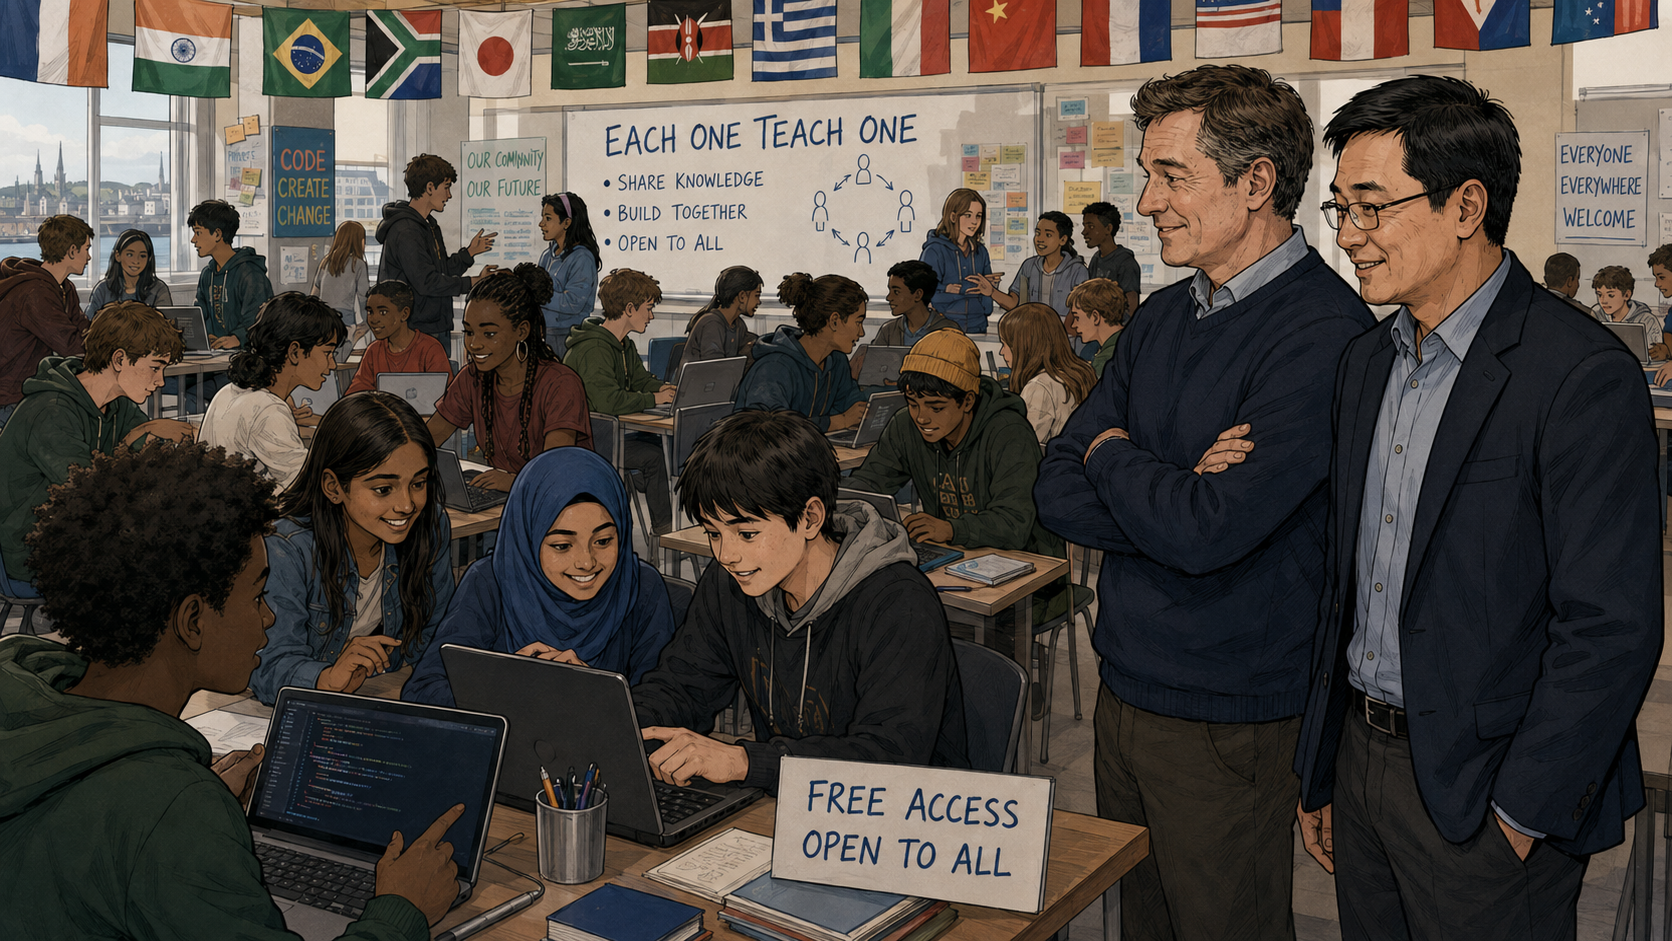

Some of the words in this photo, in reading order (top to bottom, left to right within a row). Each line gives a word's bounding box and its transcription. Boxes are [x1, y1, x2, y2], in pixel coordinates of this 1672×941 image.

[605, 123, 677, 157] EACH
[690, 121, 742, 151] ONE
[752, 114, 844, 150] TEACH
[858, 113, 918, 145] ONE
[280, 148, 326, 172] CODE
[467, 151, 491, 169] OUR
[1561, 144, 1633, 167] EVERYONE
[278, 177, 329, 198] CREATE
[467, 180, 491, 198] OUR
[497, 179, 541, 197] FUTURE
[617, 174, 666, 192] SHARE
[675, 170, 764, 190] KNOWLEDGE
[1561, 176, 1642, 197] EVERYWHERE
[277, 205, 331, 226] CHANGE
[617, 204, 662, 222] BUILD
[671, 203, 748, 221] TOGETHER
[1563, 207, 1636, 229] WELCOME
[617, 234, 658, 252] OPEN
[666, 235, 686, 252] TO
[693, 234, 724, 251] ALL
[807, 779, 887, 817] FREE
[904, 787, 1019, 829] ACCESS
[802, 830, 882, 866] OPEN
[897, 838, 937, 870] TO
[950, 843, 1012, 877] ALL
